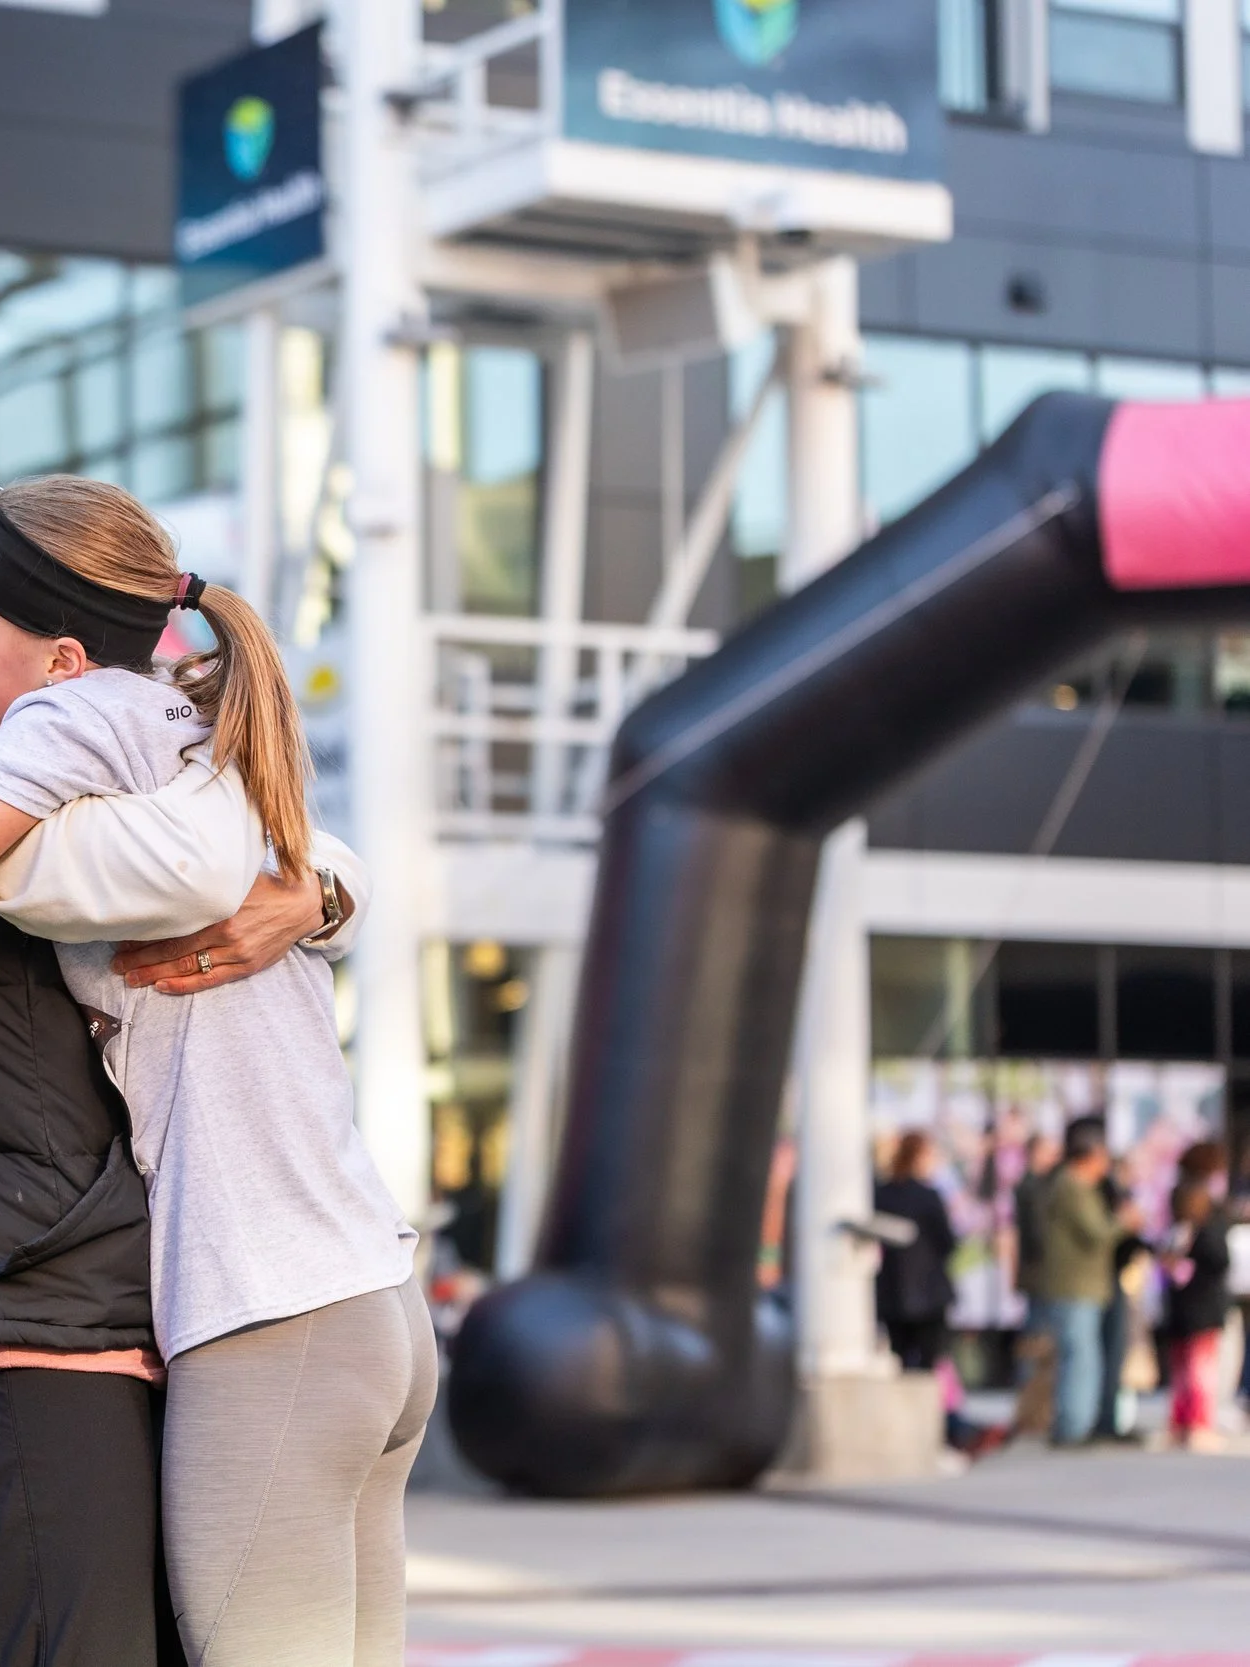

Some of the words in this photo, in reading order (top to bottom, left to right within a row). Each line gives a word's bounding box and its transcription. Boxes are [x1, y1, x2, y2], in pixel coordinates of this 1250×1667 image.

[598, 69, 771, 137] Essentia
[773, 91, 908, 154] Health
[165, 705, 192, 721] BIO
